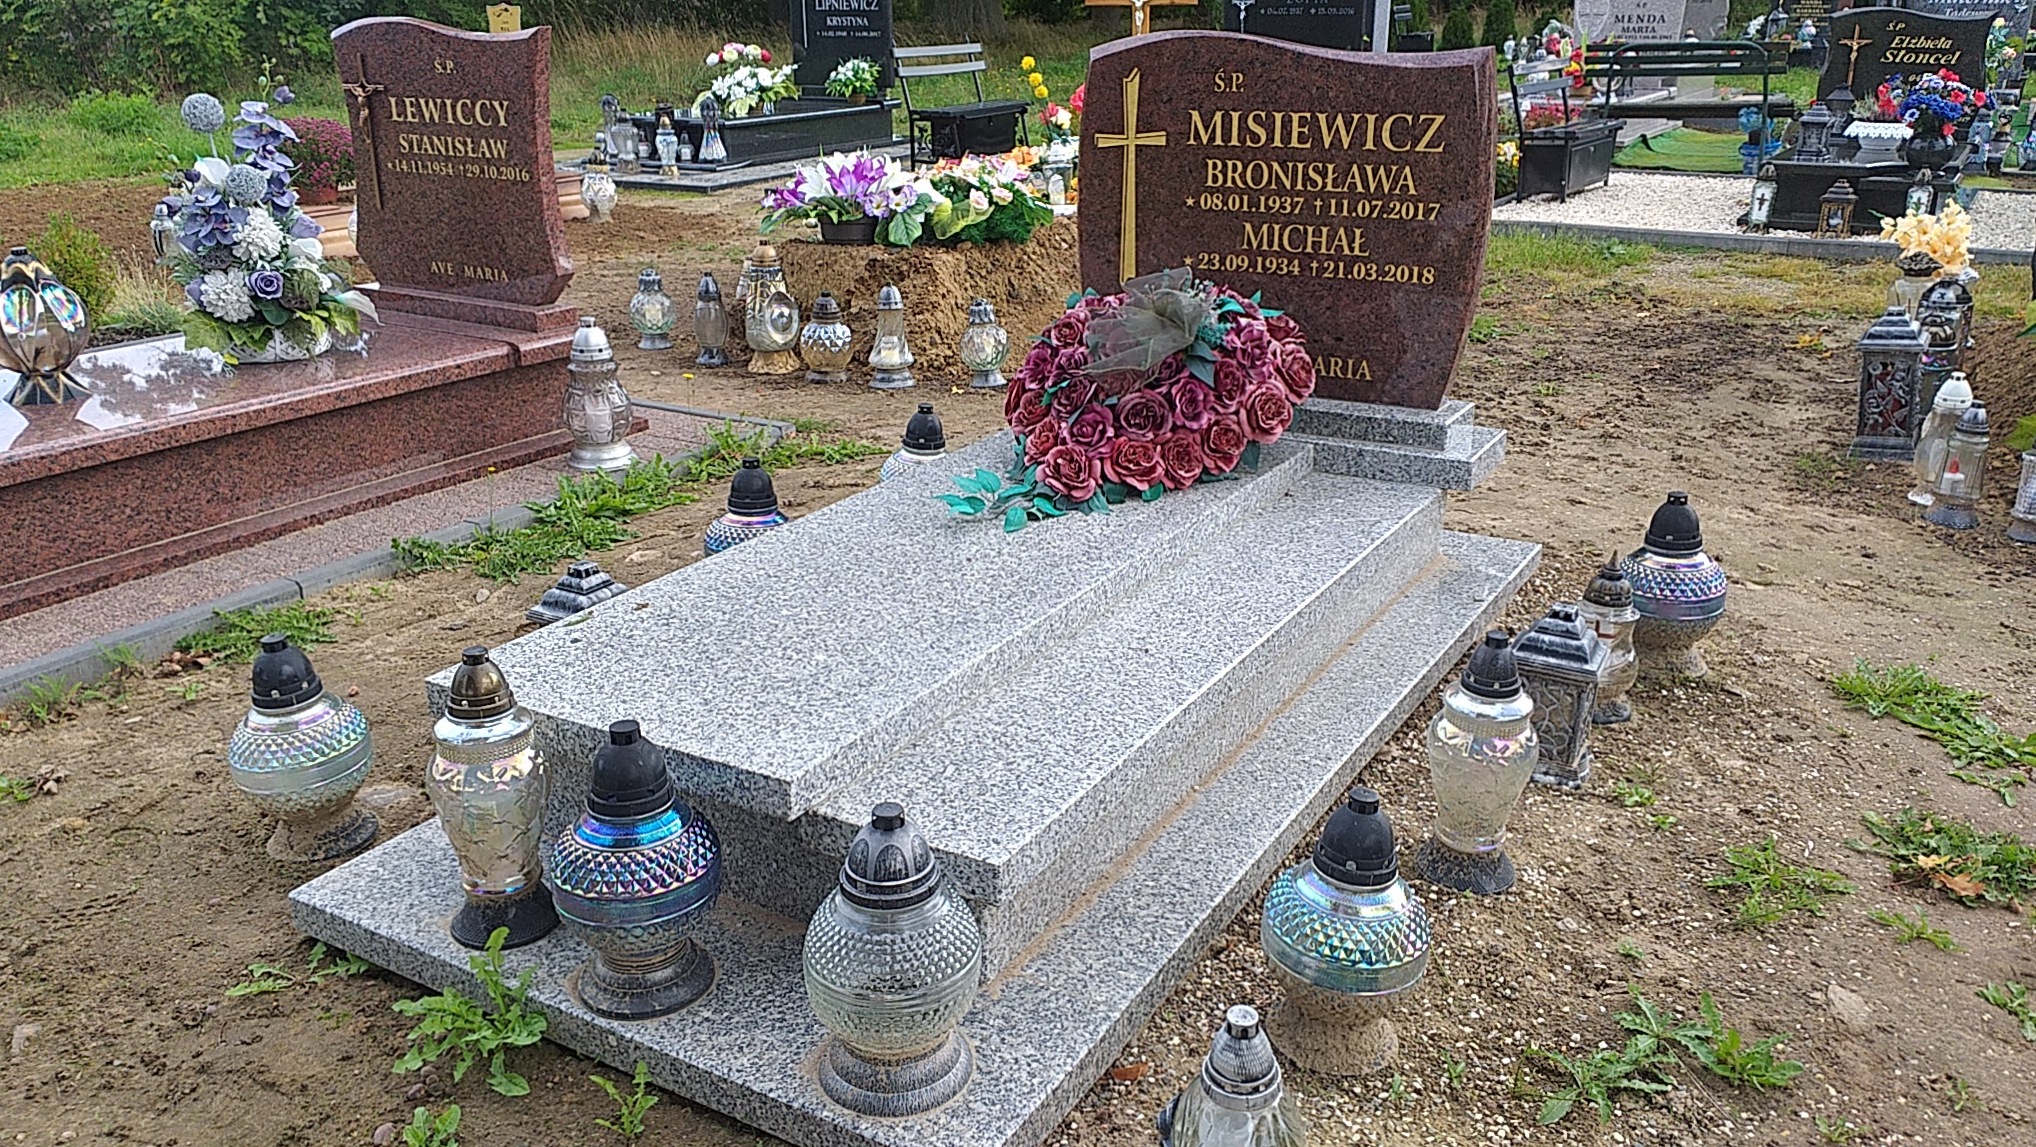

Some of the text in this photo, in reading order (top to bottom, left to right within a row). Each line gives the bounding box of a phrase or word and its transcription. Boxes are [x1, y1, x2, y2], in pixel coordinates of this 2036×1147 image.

[815, 0, 879, 11] LIPNIEWICZ
[826, 16, 869, 27] KRYSTYNA
[1614, 14, 1667, 25] MENDA
[1621, 26, 1657, 34] MARTA
[1890, 35, 1954, 49] Elżbieta
[1214, 68, 1245, 93] Ś.P.
[388, 96, 509, 127] LEWICCY
[1186, 109, 1446, 153] MISIEWICZ
[399, 133, 508, 159] STANISŁAW
[394, 159, 530, 181] 14.11.1954 29.10.2016
[1205, 158, 1418, 196] BRONISŁAWA
[1200, 192, 1441, 222] 08.01.1937 11.07.2017
[1241, 221, 1370, 258] MICHAŁ
[430, 260, 509, 283] AVE MARIA
[1198, 252, 1436, 285] 23.09.1934 21.03.2018
[1312, 355, 1373, 381] ARIA
